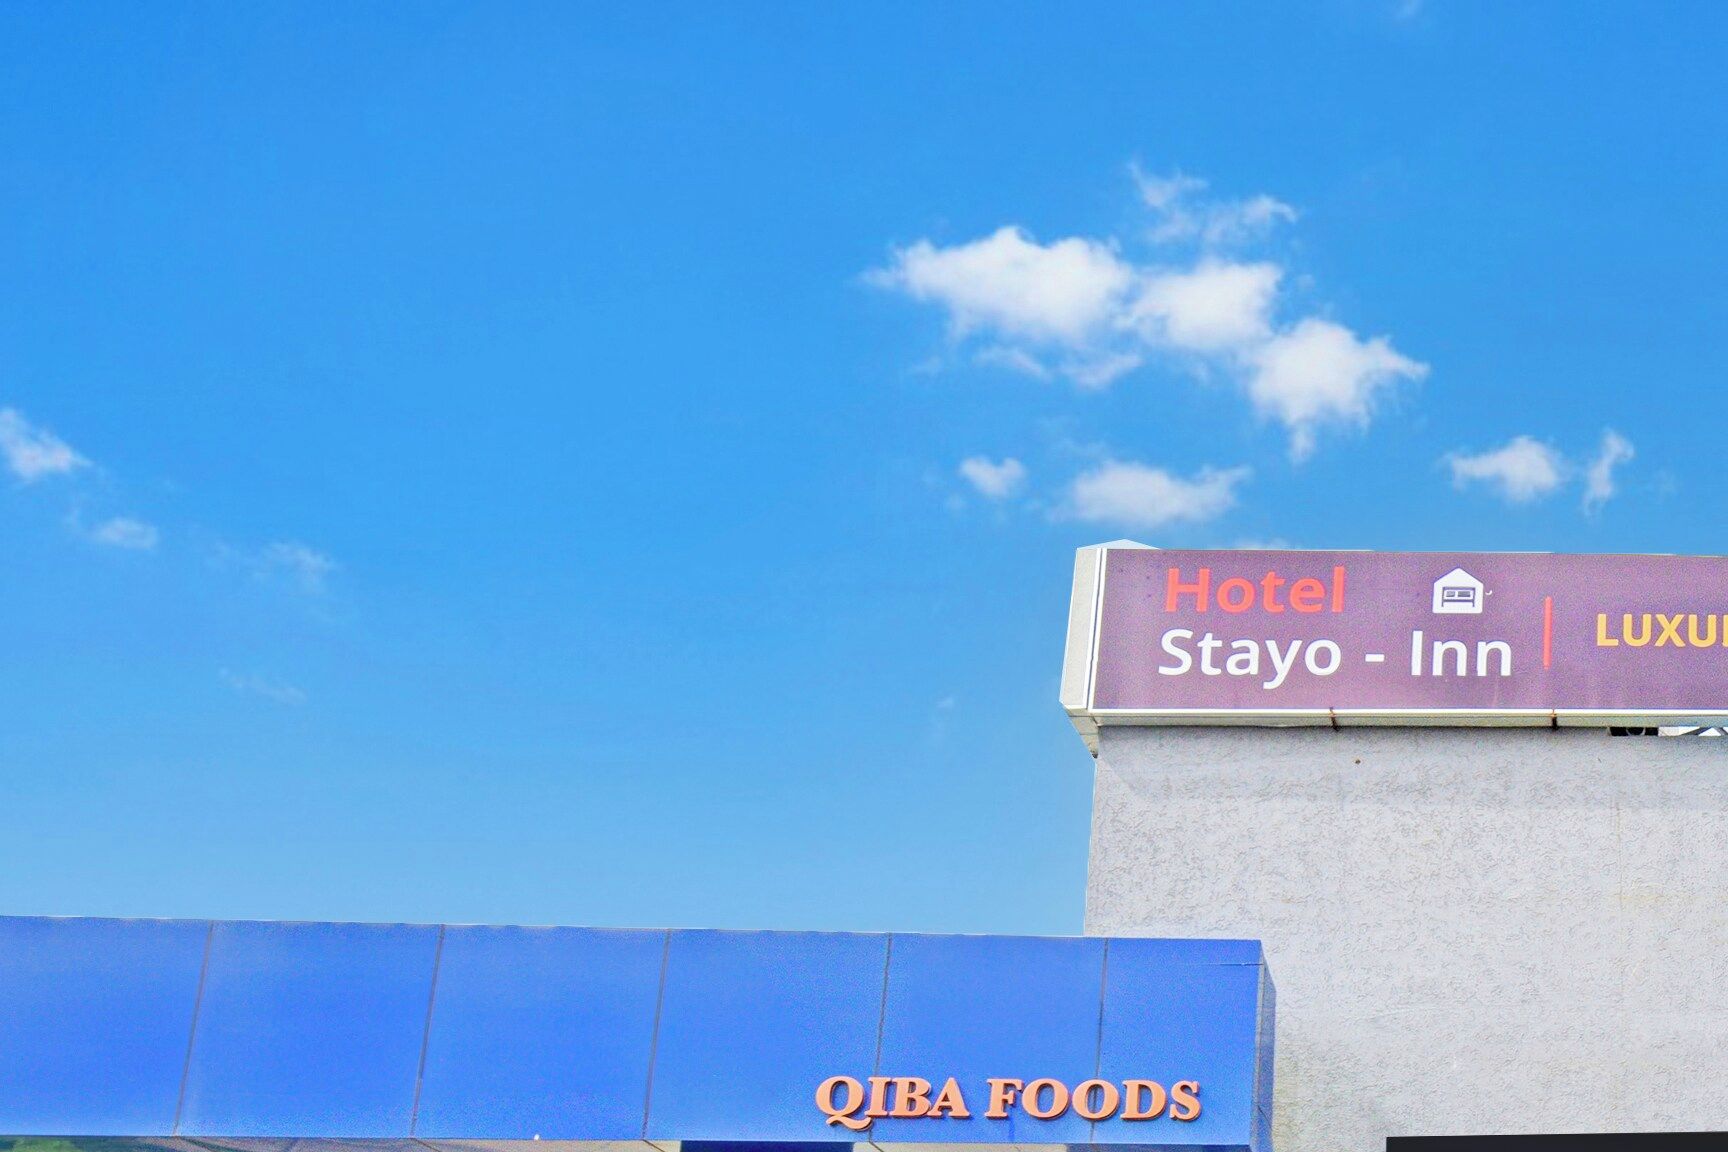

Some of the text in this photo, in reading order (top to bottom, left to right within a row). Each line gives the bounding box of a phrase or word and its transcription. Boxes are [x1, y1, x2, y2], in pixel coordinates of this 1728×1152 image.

[1165, 565, 1346, 614] Hotel
[1158, 628, 1343, 690] Stayo
[1411, 630, 1513, 678] Inn
[815, 1076, 1202, 1130] QIBA FOODS
